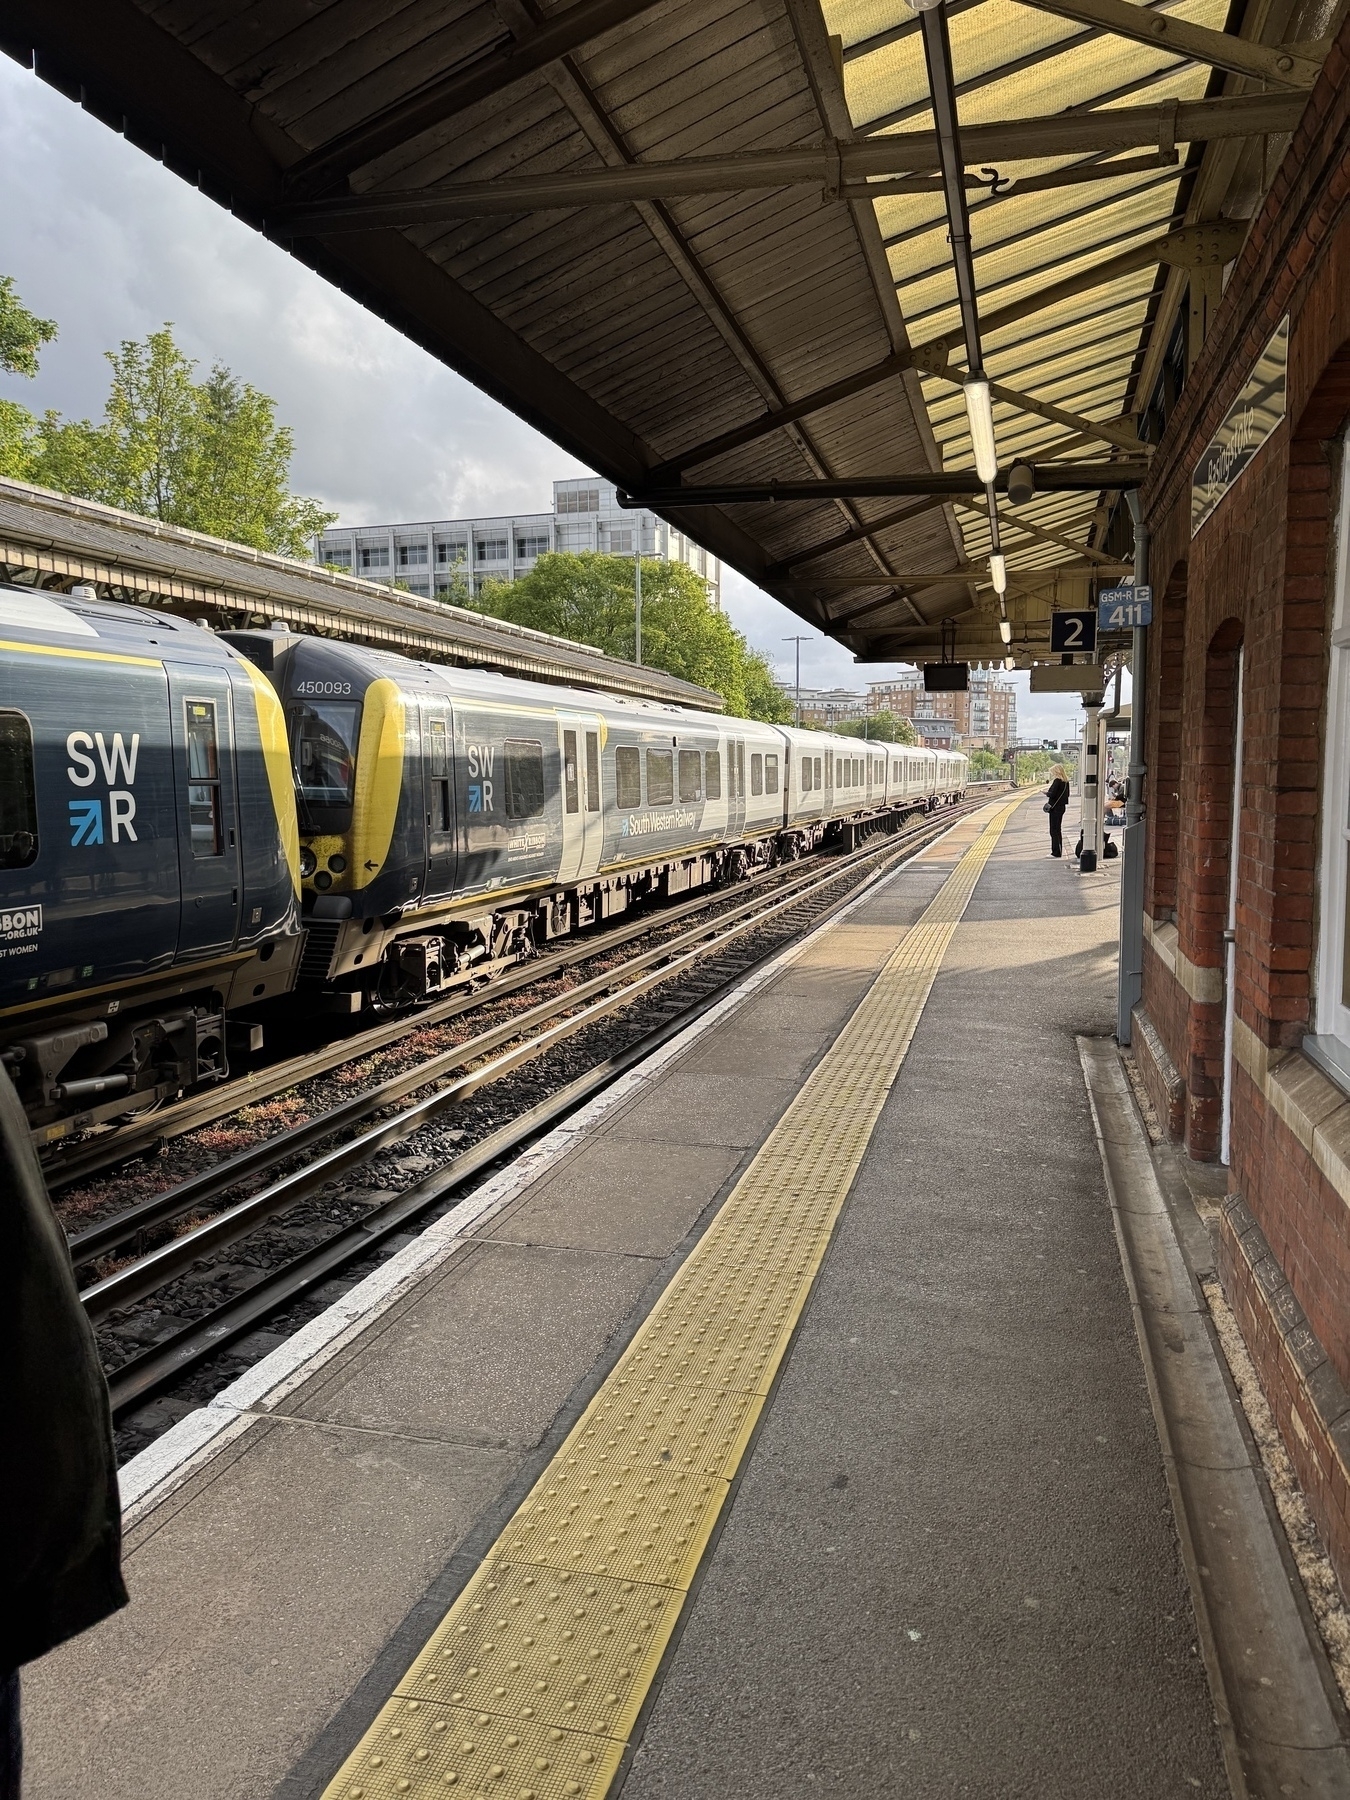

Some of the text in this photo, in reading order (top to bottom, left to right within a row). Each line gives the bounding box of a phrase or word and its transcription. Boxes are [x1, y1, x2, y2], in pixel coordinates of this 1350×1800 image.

[1207, 405, 1254, 497] Basingstoke
[1101, 590, 1132, 602] GSM-R
[1109, 604, 1142, 626] 411
[1063, 618, 1084, 647] 2
[296, 681, 351, 695] 450093
[66, 731, 140, 787] SW
[467, 746, 495, 778] SW
[483, 780, 494, 812] R
[109, 790, 138, 843] R
[629, 808, 696, 836] South Western Railway
[9, 943, 38, 956] WOMEN
